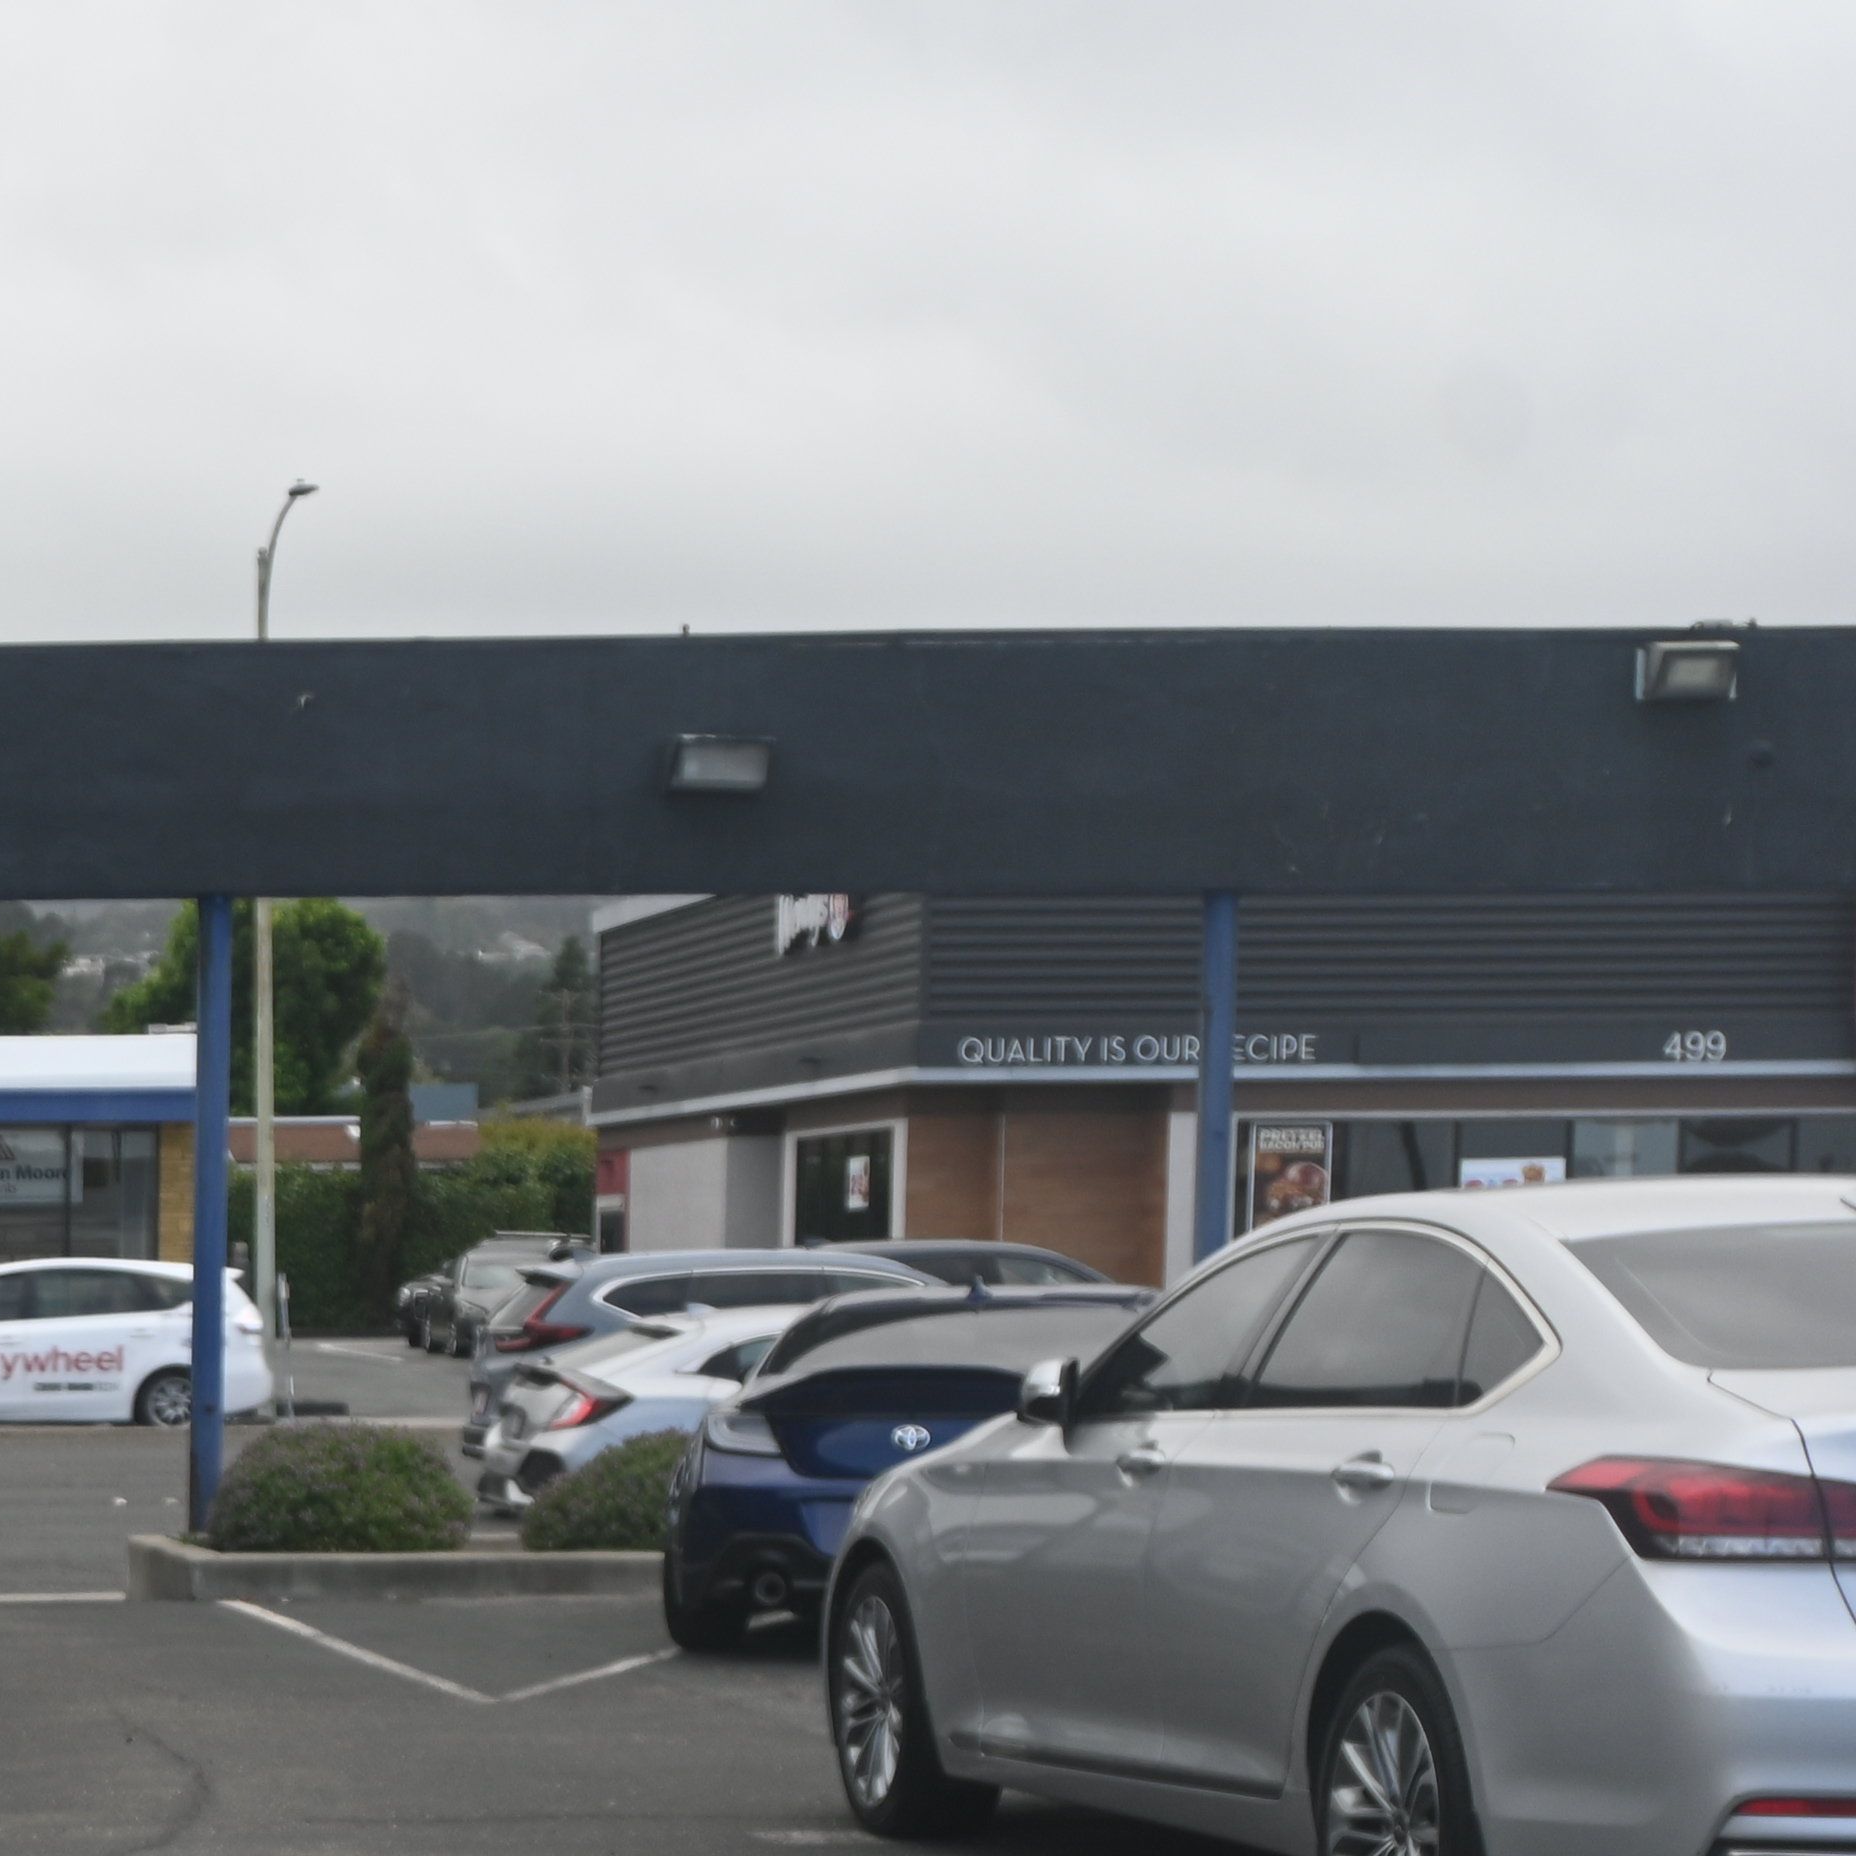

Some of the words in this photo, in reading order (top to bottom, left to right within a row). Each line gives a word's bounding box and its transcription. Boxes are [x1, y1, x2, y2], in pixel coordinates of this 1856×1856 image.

[960, 1035, 1092, 1063] QUALITY
[1100, 1035, 1126, 1062] IS
[1133, 1035, 1201, 1062] OUR
[1233, 1033, 1317, 1061] ECIPE
[1662, 1029, 1727, 1063] 499
